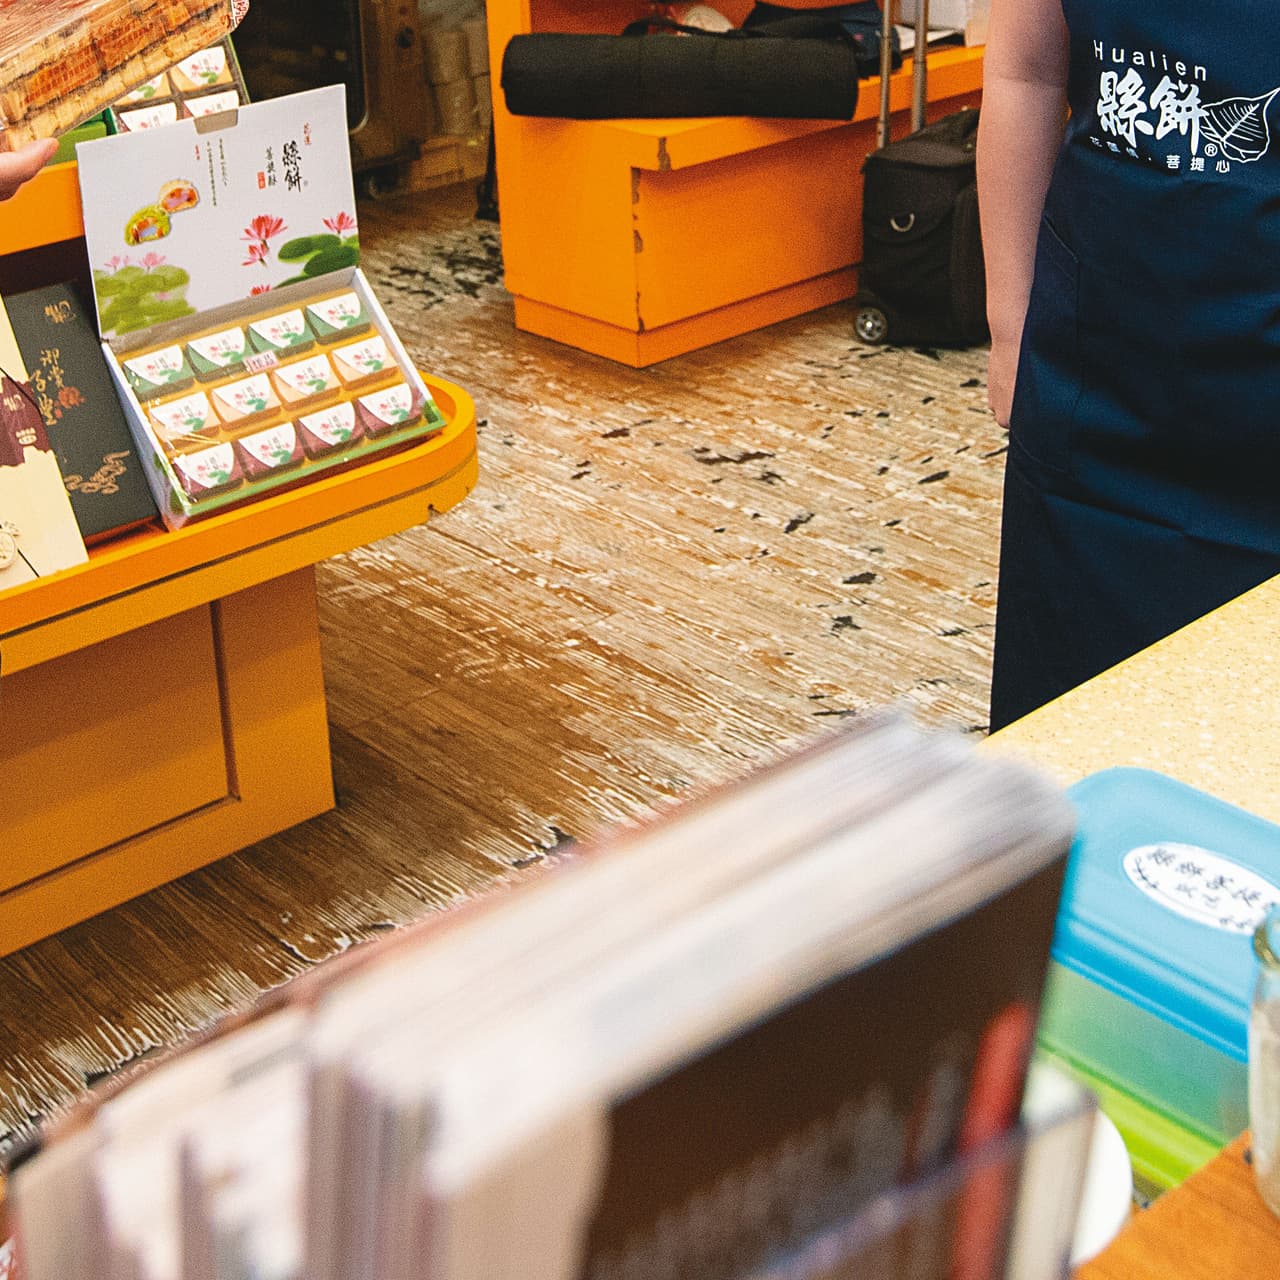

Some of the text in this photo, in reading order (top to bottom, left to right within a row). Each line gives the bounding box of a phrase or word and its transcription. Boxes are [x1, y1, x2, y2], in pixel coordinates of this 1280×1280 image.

[1093, 39, 1207, 82] Hualien
[1096, 67, 1209, 156] 縣餅
[1166, 154, 1231, 173] 菩提心
